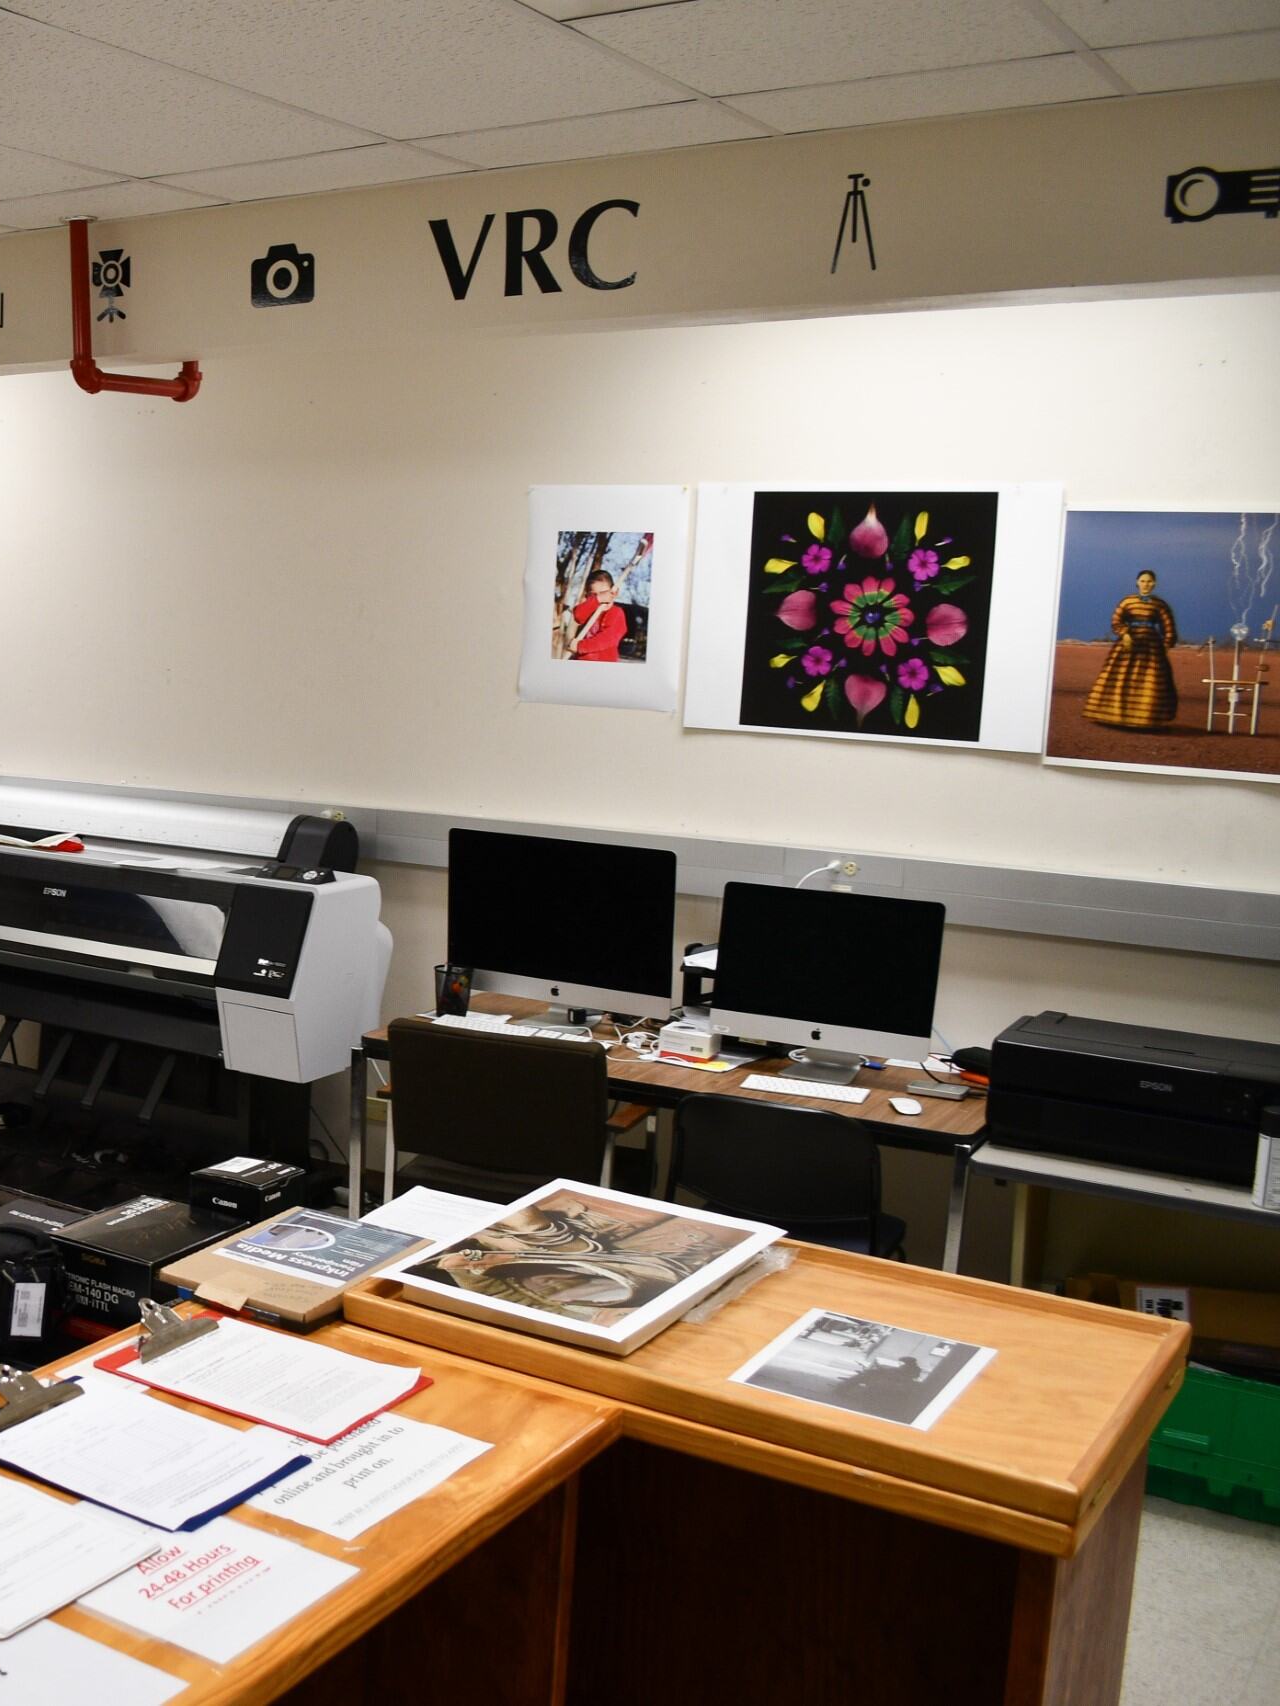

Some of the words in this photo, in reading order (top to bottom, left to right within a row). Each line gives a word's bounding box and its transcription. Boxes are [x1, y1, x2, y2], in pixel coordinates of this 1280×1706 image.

[428, 198, 640, 301] VRC
[43, 887, 67, 898] EPSON
[1139, 1078, 1174, 1093] EPSON
[212, 1196, 238, 1209] Canon
[264, 1191, 281, 1202] Canon
[236, 1242, 288, 1261] Media
[288, 1256, 350, 1279] Inkpress
[91, 1278, 113, 1293] FLASH
[112, 1285, 136, 1299] MACRO
[104, 1291, 120, 1305] DG
[274, 1480, 314, 1505] online
[312, 1465, 337, 1483] and
[333, 1443, 377, 1470] brought
[376, 1432, 391, 1444] in
[388, 1425, 404, 1437] to
[343, 1467, 375, 1489] print
[136, 1546, 181, 1575] Allow
[138, 1569, 186, 1599] 24-48
[183, 1544, 231, 1572] Hours
[168, 1590, 197, 1609] For
[198, 1555, 261, 1595] printing
